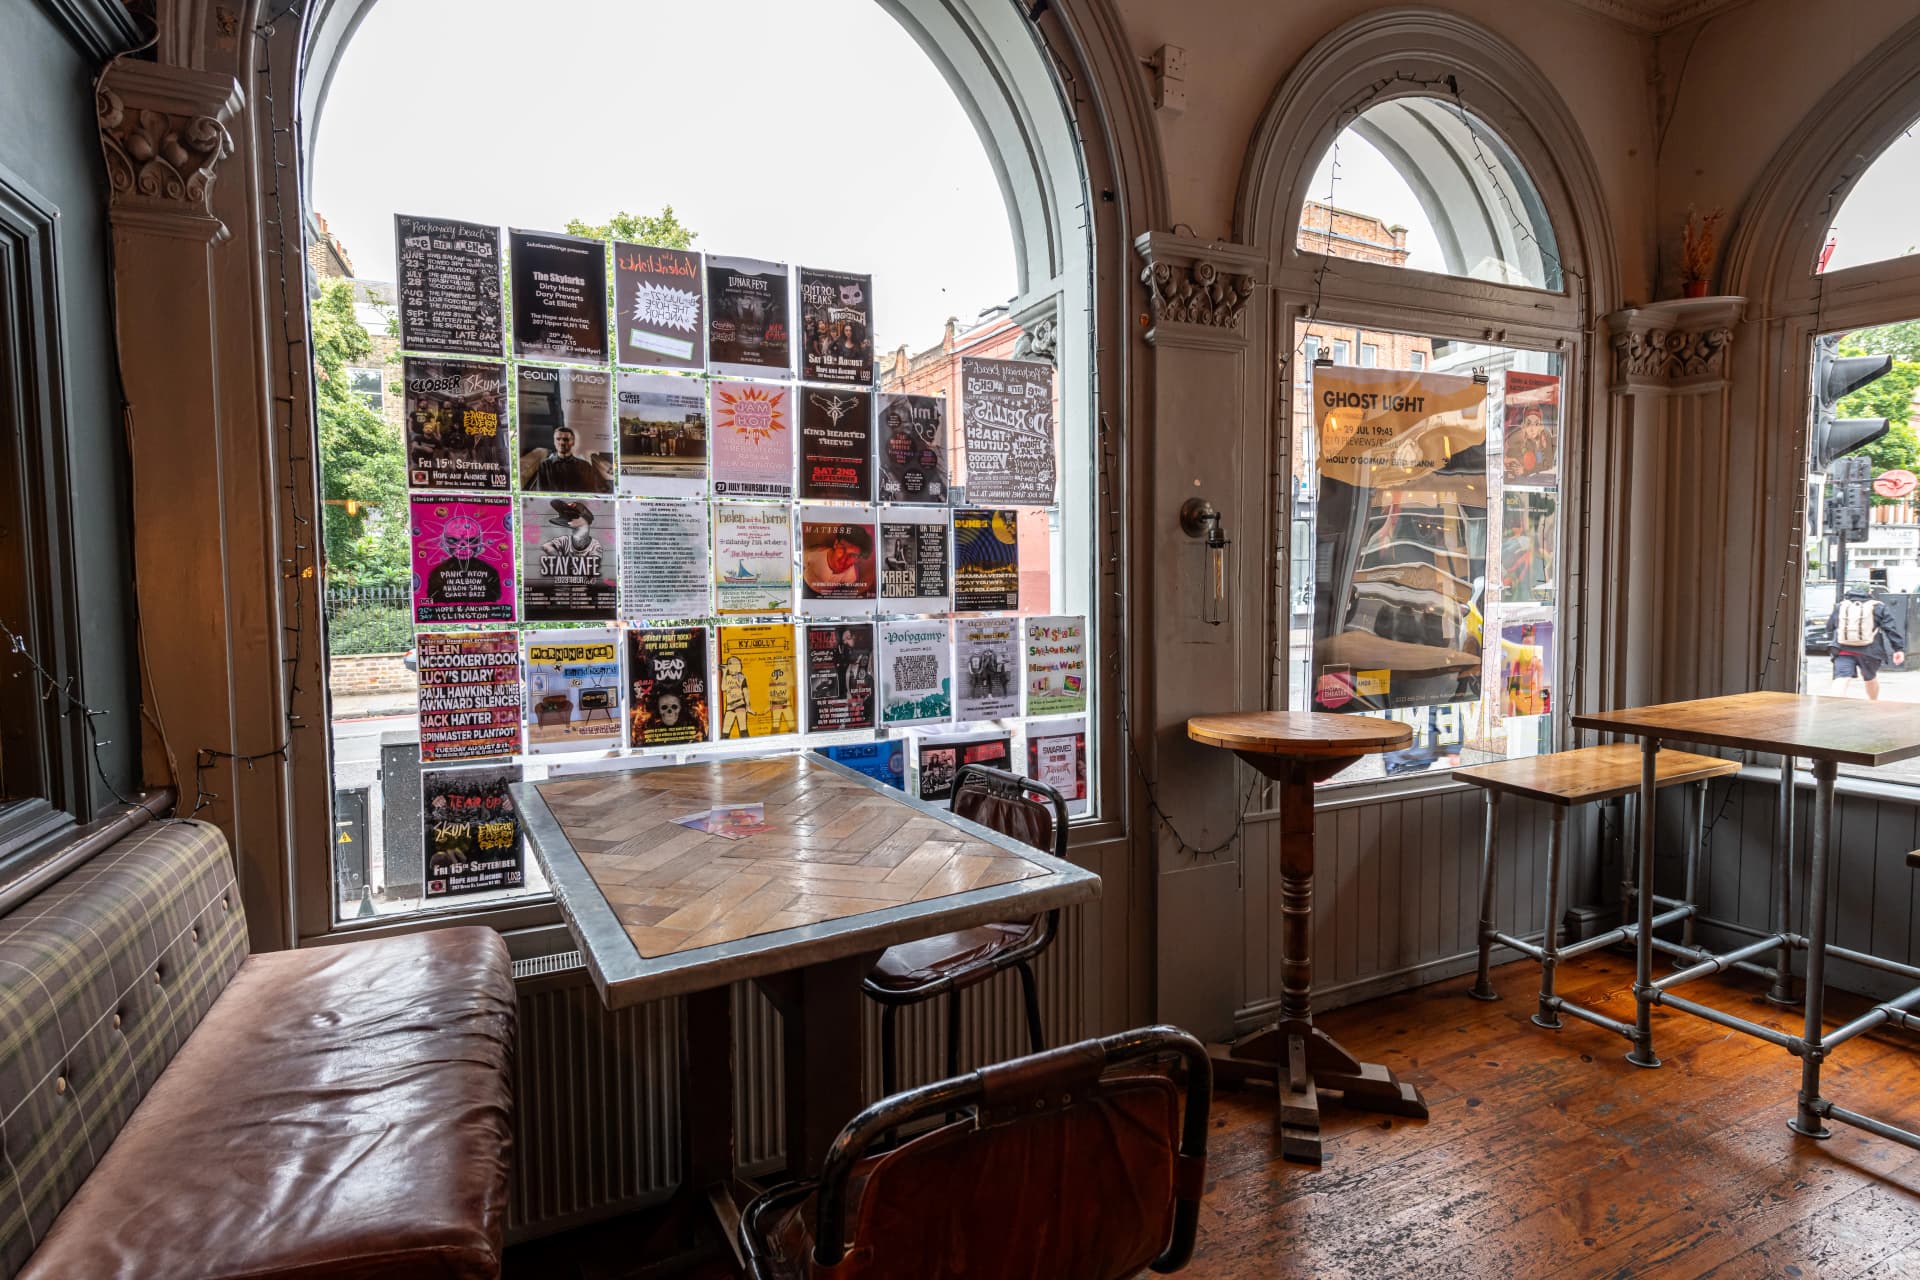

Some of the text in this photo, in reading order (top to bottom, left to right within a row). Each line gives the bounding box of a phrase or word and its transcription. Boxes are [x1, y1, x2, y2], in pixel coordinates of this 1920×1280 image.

[532, 271, 585, 287] The Skylarks
[728, 276, 769, 291] LUNAR FEST
[539, 282, 580, 294] Dirty Horse
[535, 290, 584, 302] Dory Preverts
[803, 292, 833, 305] FREAKS
[542, 298, 578, 309] Cat Elliott
[455, 331, 478, 340] LATE
[479, 332, 497, 341] BAR
[523, 370, 558, 382] COLIN
[410, 374, 500, 394] CLOBBER SKUM
[738, 400, 768, 413] JAM
[1323, 390, 1425, 413] GHOST LIGHT
[737, 417, 769, 427] HOT
[803, 428, 866, 439] KIND HEARTED
[1356, 426, 1370, 436] JUL
[1372, 427, 1393, 437] 19:45
[818, 437, 854, 446] THIEVES
[1326, 456, 1349, 464] MOLLY
[728, 482, 740, 491] JULY
[741, 483, 769, 493] THURSDAY
[718, 510, 745, 524] helen
[805, 525, 852, 535] MATISSE
[929, 525, 943, 533] TOUR
[540, 556, 601, 576] STAY SAFE
[440, 570, 465, 579] PANIC
[882, 570, 916, 584] KAREN
[882, 583, 916, 597] JONAS
[437, 612, 488, 620] ISLINGTON
[419, 644, 461, 656] HELEN
[531, 648, 584, 661] MORNING
[420, 653, 519, 668] MCCOOKERYBOOK
[653, 658, 685, 672] DEAD
[420, 669, 494, 685] LUCY'S DIARY
[655, 670, 683, 681] JAW
[420, 687, 446, 700] PAUL
[447, 685, 493, 699] HAWKINS
[493, 684, 505, 696] AND
[474, 694, 520, 708] SILENCES
[421, 711, 492, 727] JACK HAYTER
[421, 727, 515, 743] SPINMASTER PLANTPOT
[448, 795, 501, 809] TEAR UP
[433, 820, 472, 842] SKUM
